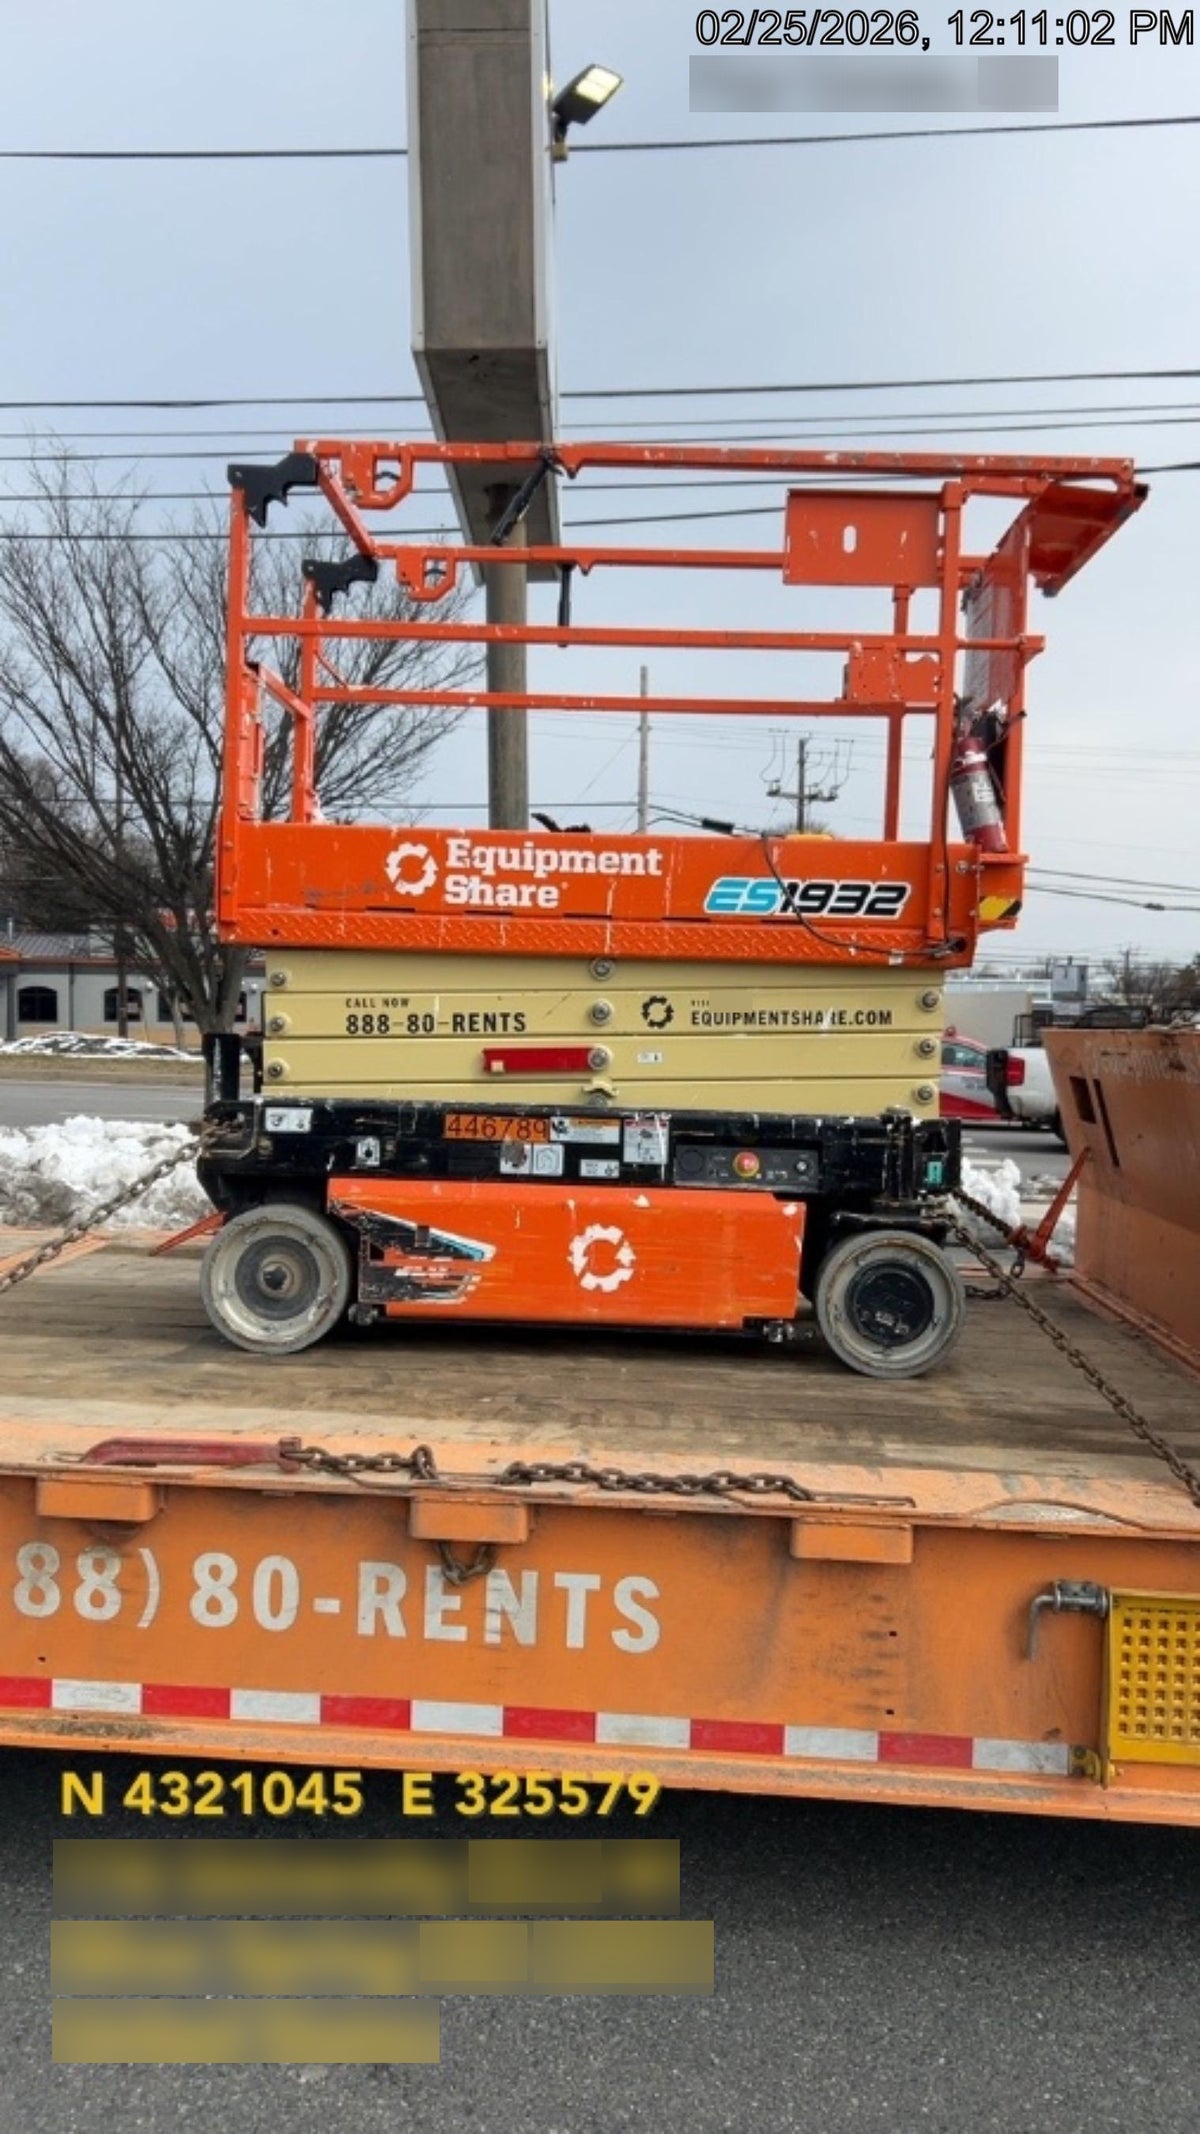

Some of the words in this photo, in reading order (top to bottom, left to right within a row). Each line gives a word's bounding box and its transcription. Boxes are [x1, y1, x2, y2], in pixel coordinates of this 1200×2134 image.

[445, 838, 663, 878] Equipment
[444, 874, 560, 909] Share
[705, 877, 911, 918] ES1932
[345, 998, 376, 1009] CALL
[381, 997, 411, 1008] NOW
[345, 1012, 527, 1034] 888-80-RENTS
[447, 1115, 547, 1140] 446789
[188, 1552, 662, 1654] 80-RENTS
